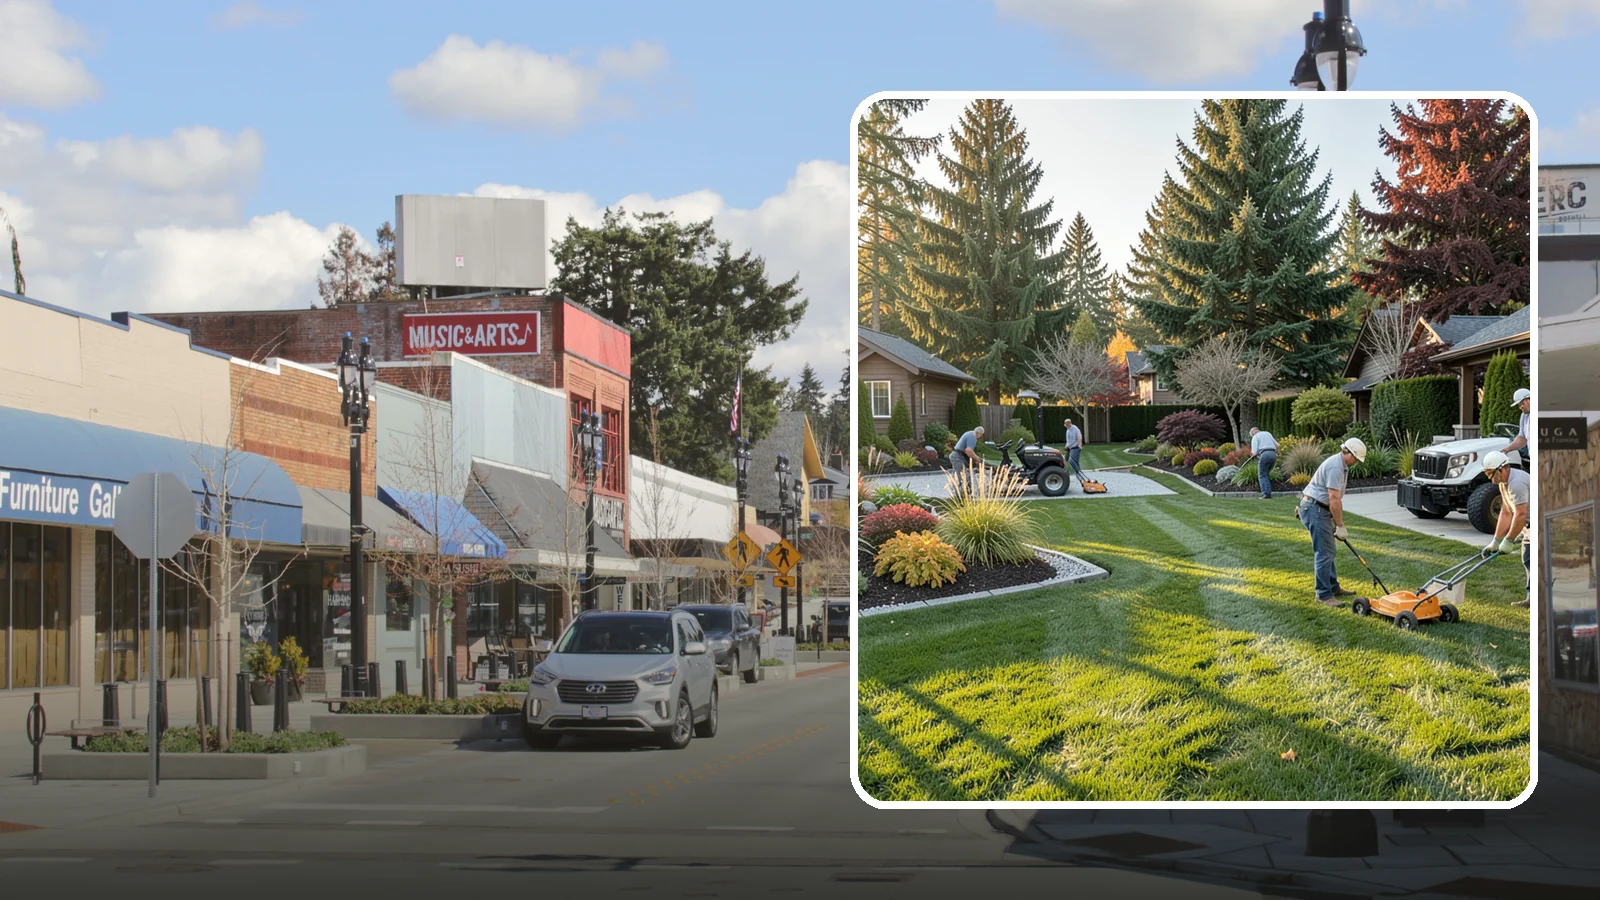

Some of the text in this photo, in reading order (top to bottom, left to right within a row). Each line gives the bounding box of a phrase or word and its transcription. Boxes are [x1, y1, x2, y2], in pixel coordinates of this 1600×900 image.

[408, 323, 520, 349] MUSIC&ARTS
[0, 471, 79, 515] Furniture
[453, 563, 480, 574] SUSHI
